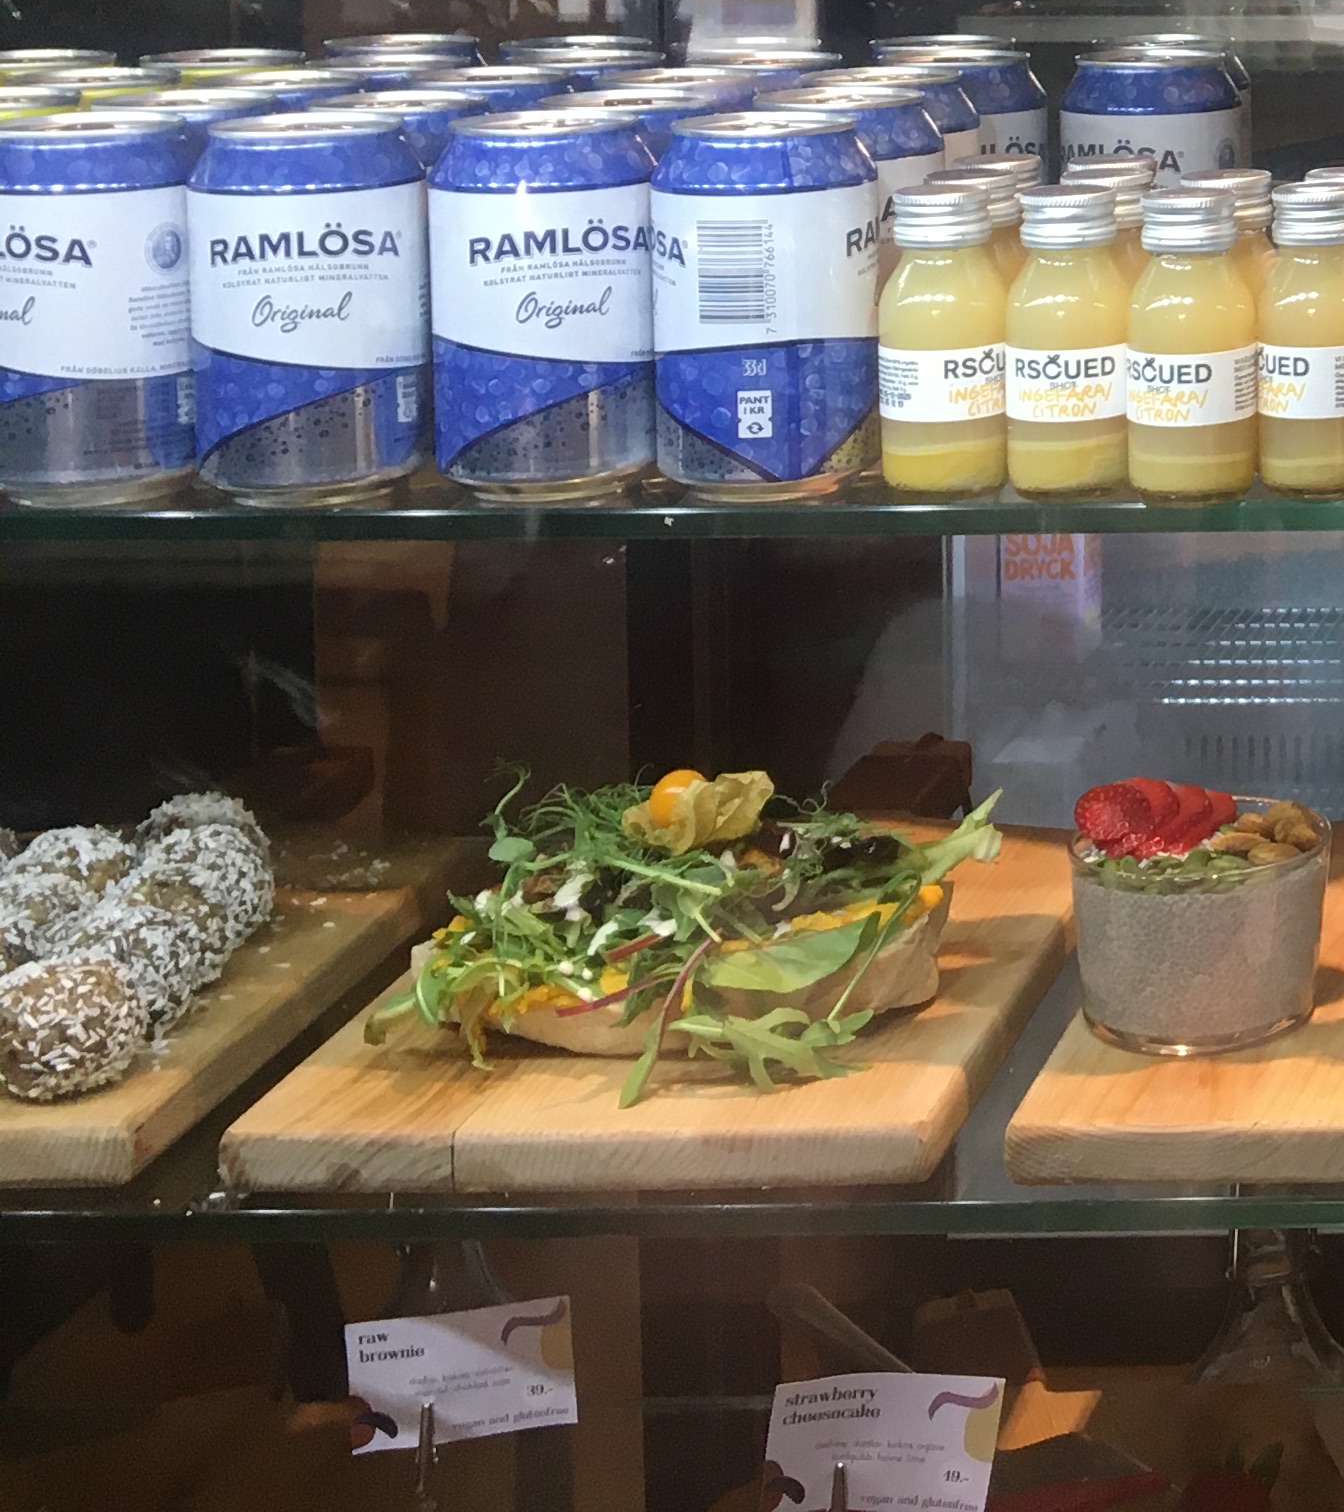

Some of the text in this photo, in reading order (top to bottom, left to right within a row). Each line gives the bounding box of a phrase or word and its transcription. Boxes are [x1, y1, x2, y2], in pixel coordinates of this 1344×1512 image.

[208, 222, 401, 268] RAMLÖSA
[468, 218, 650, 267] RAMLÖSA
[251, 291, 353, 333] Original
[515, 286, 613, 329] Original
[739, 395, 770, 405] PANT
[1005, 533, 1076, 557] SOJA
[1004, 557, 1076, 581] DRYCK
[357, 1330, 390, 1346] raw
[358, 1344, 426, 1364] brownie
[784, 1386, 880, 1408] strawberry
[781, 1406, 882, 1427] cheesecake
